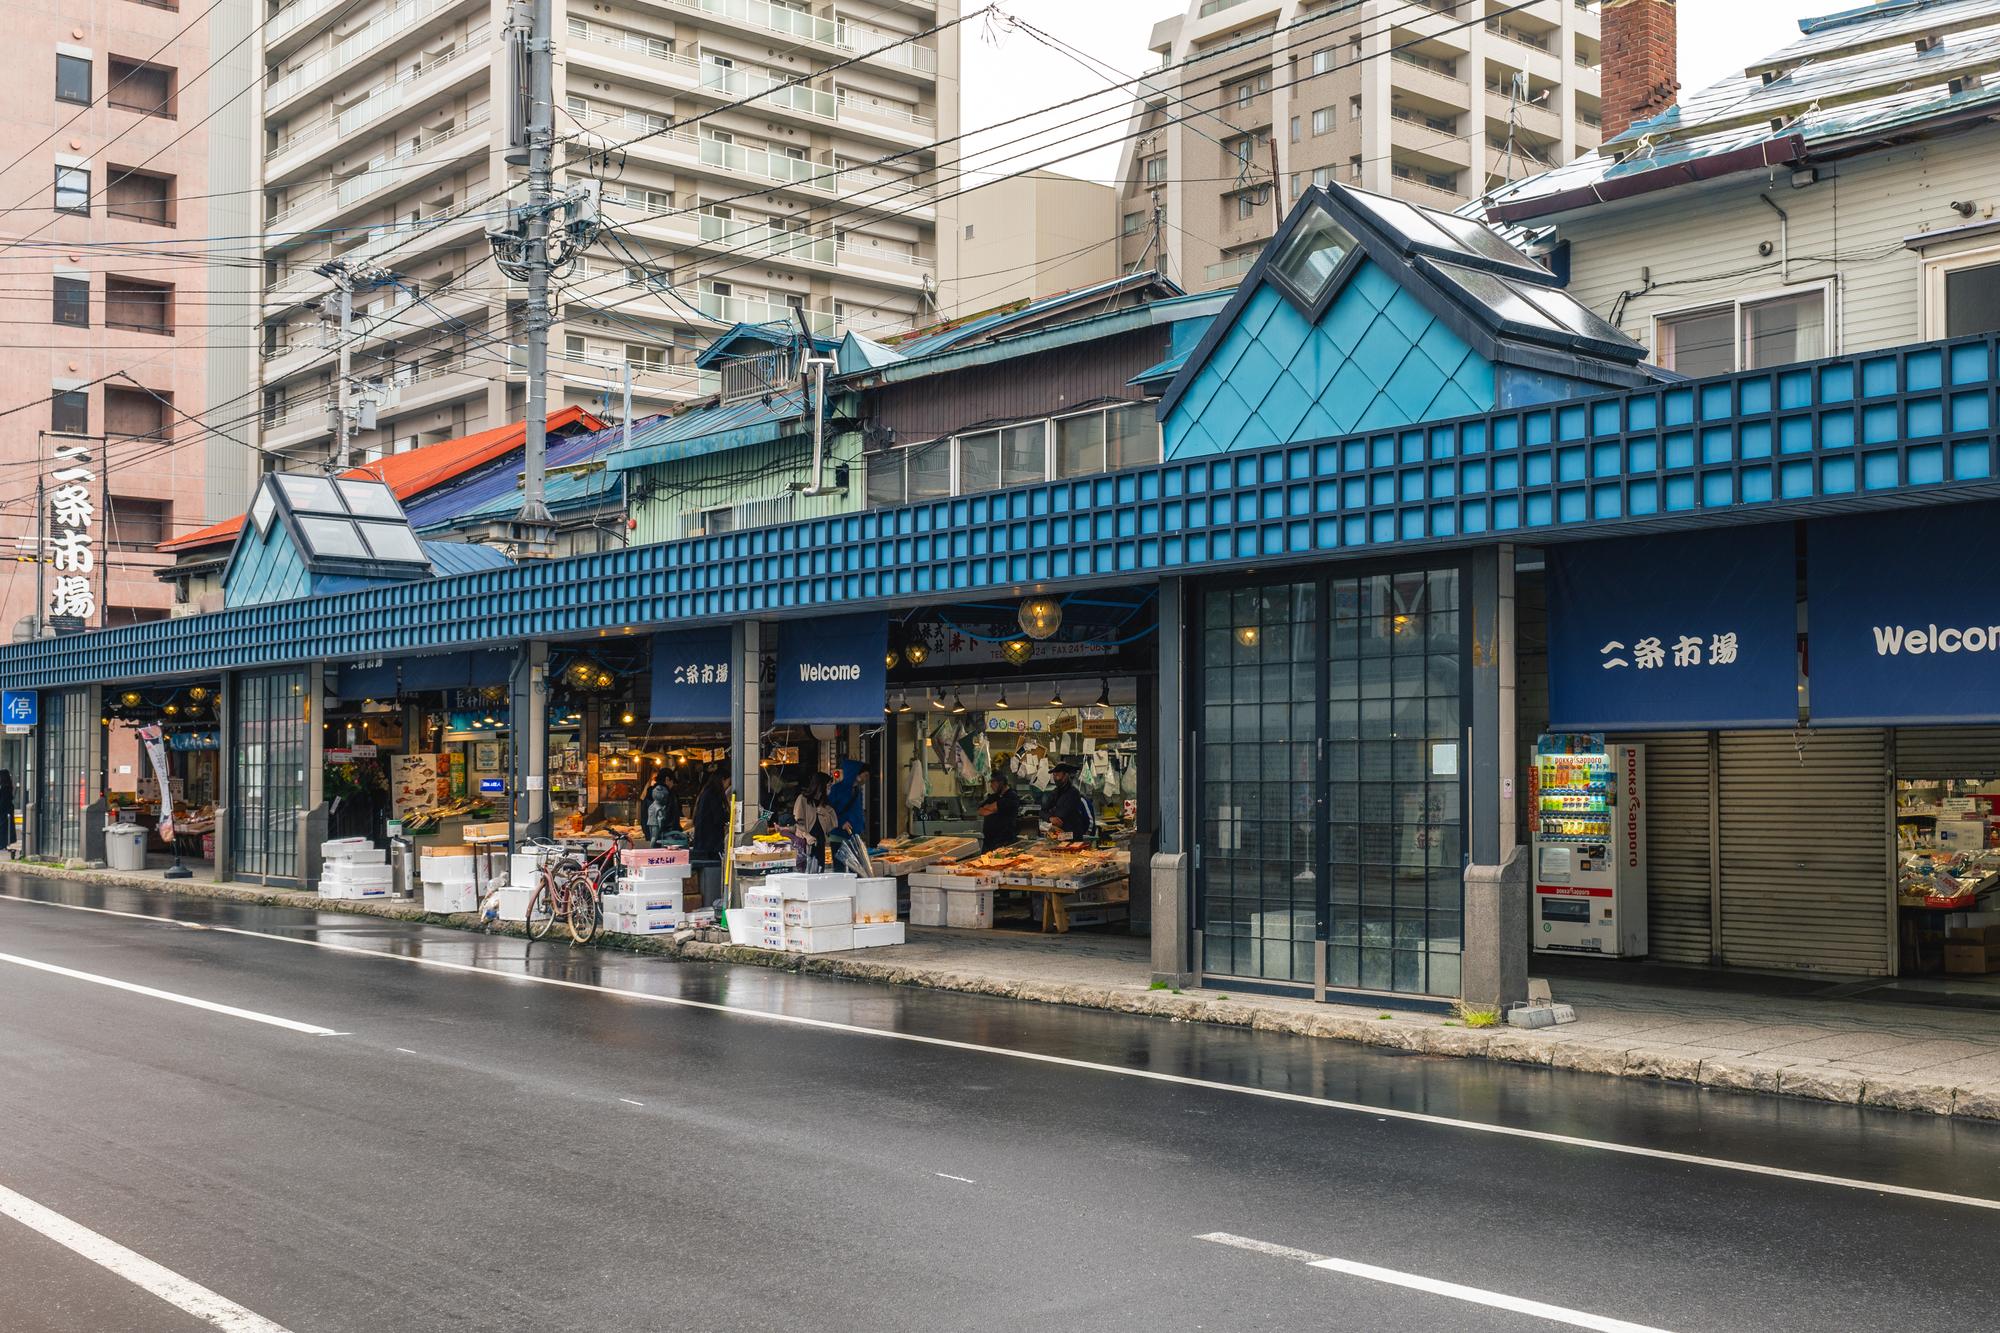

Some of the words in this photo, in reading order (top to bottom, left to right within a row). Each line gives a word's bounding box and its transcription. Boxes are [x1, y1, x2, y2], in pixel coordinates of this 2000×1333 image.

[51, 445, 97, 619] 二条市場
[1600, 632, 1739, 670] 二条市場
[673, 663, 728, 685] 二条市場
[799, 662, 861, 682] Welcome
[8, 697, 32, 719] 停
